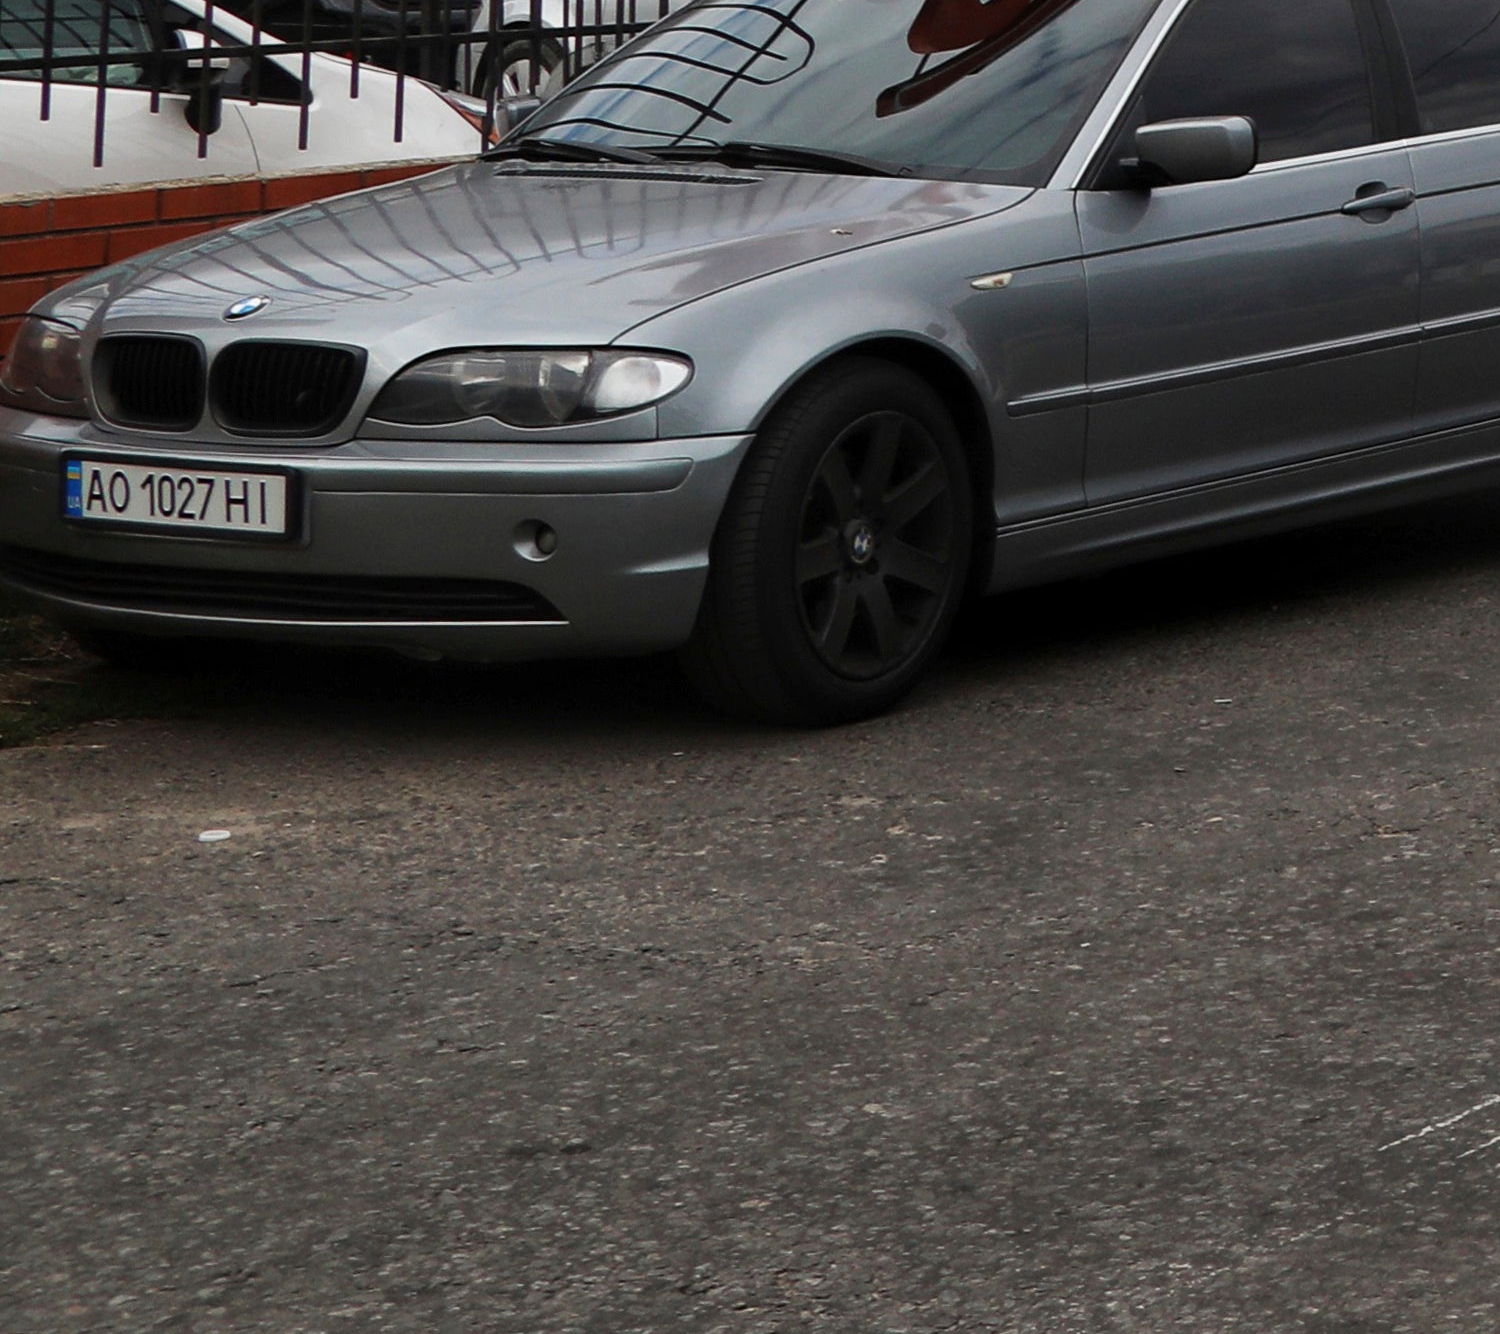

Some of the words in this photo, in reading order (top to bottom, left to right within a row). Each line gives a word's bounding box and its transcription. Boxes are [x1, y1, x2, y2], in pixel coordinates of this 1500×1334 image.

[86, 469, 131, 513] AO
[140, 473, 216, 521] 1027
[224, 479, 267, 525] HI
